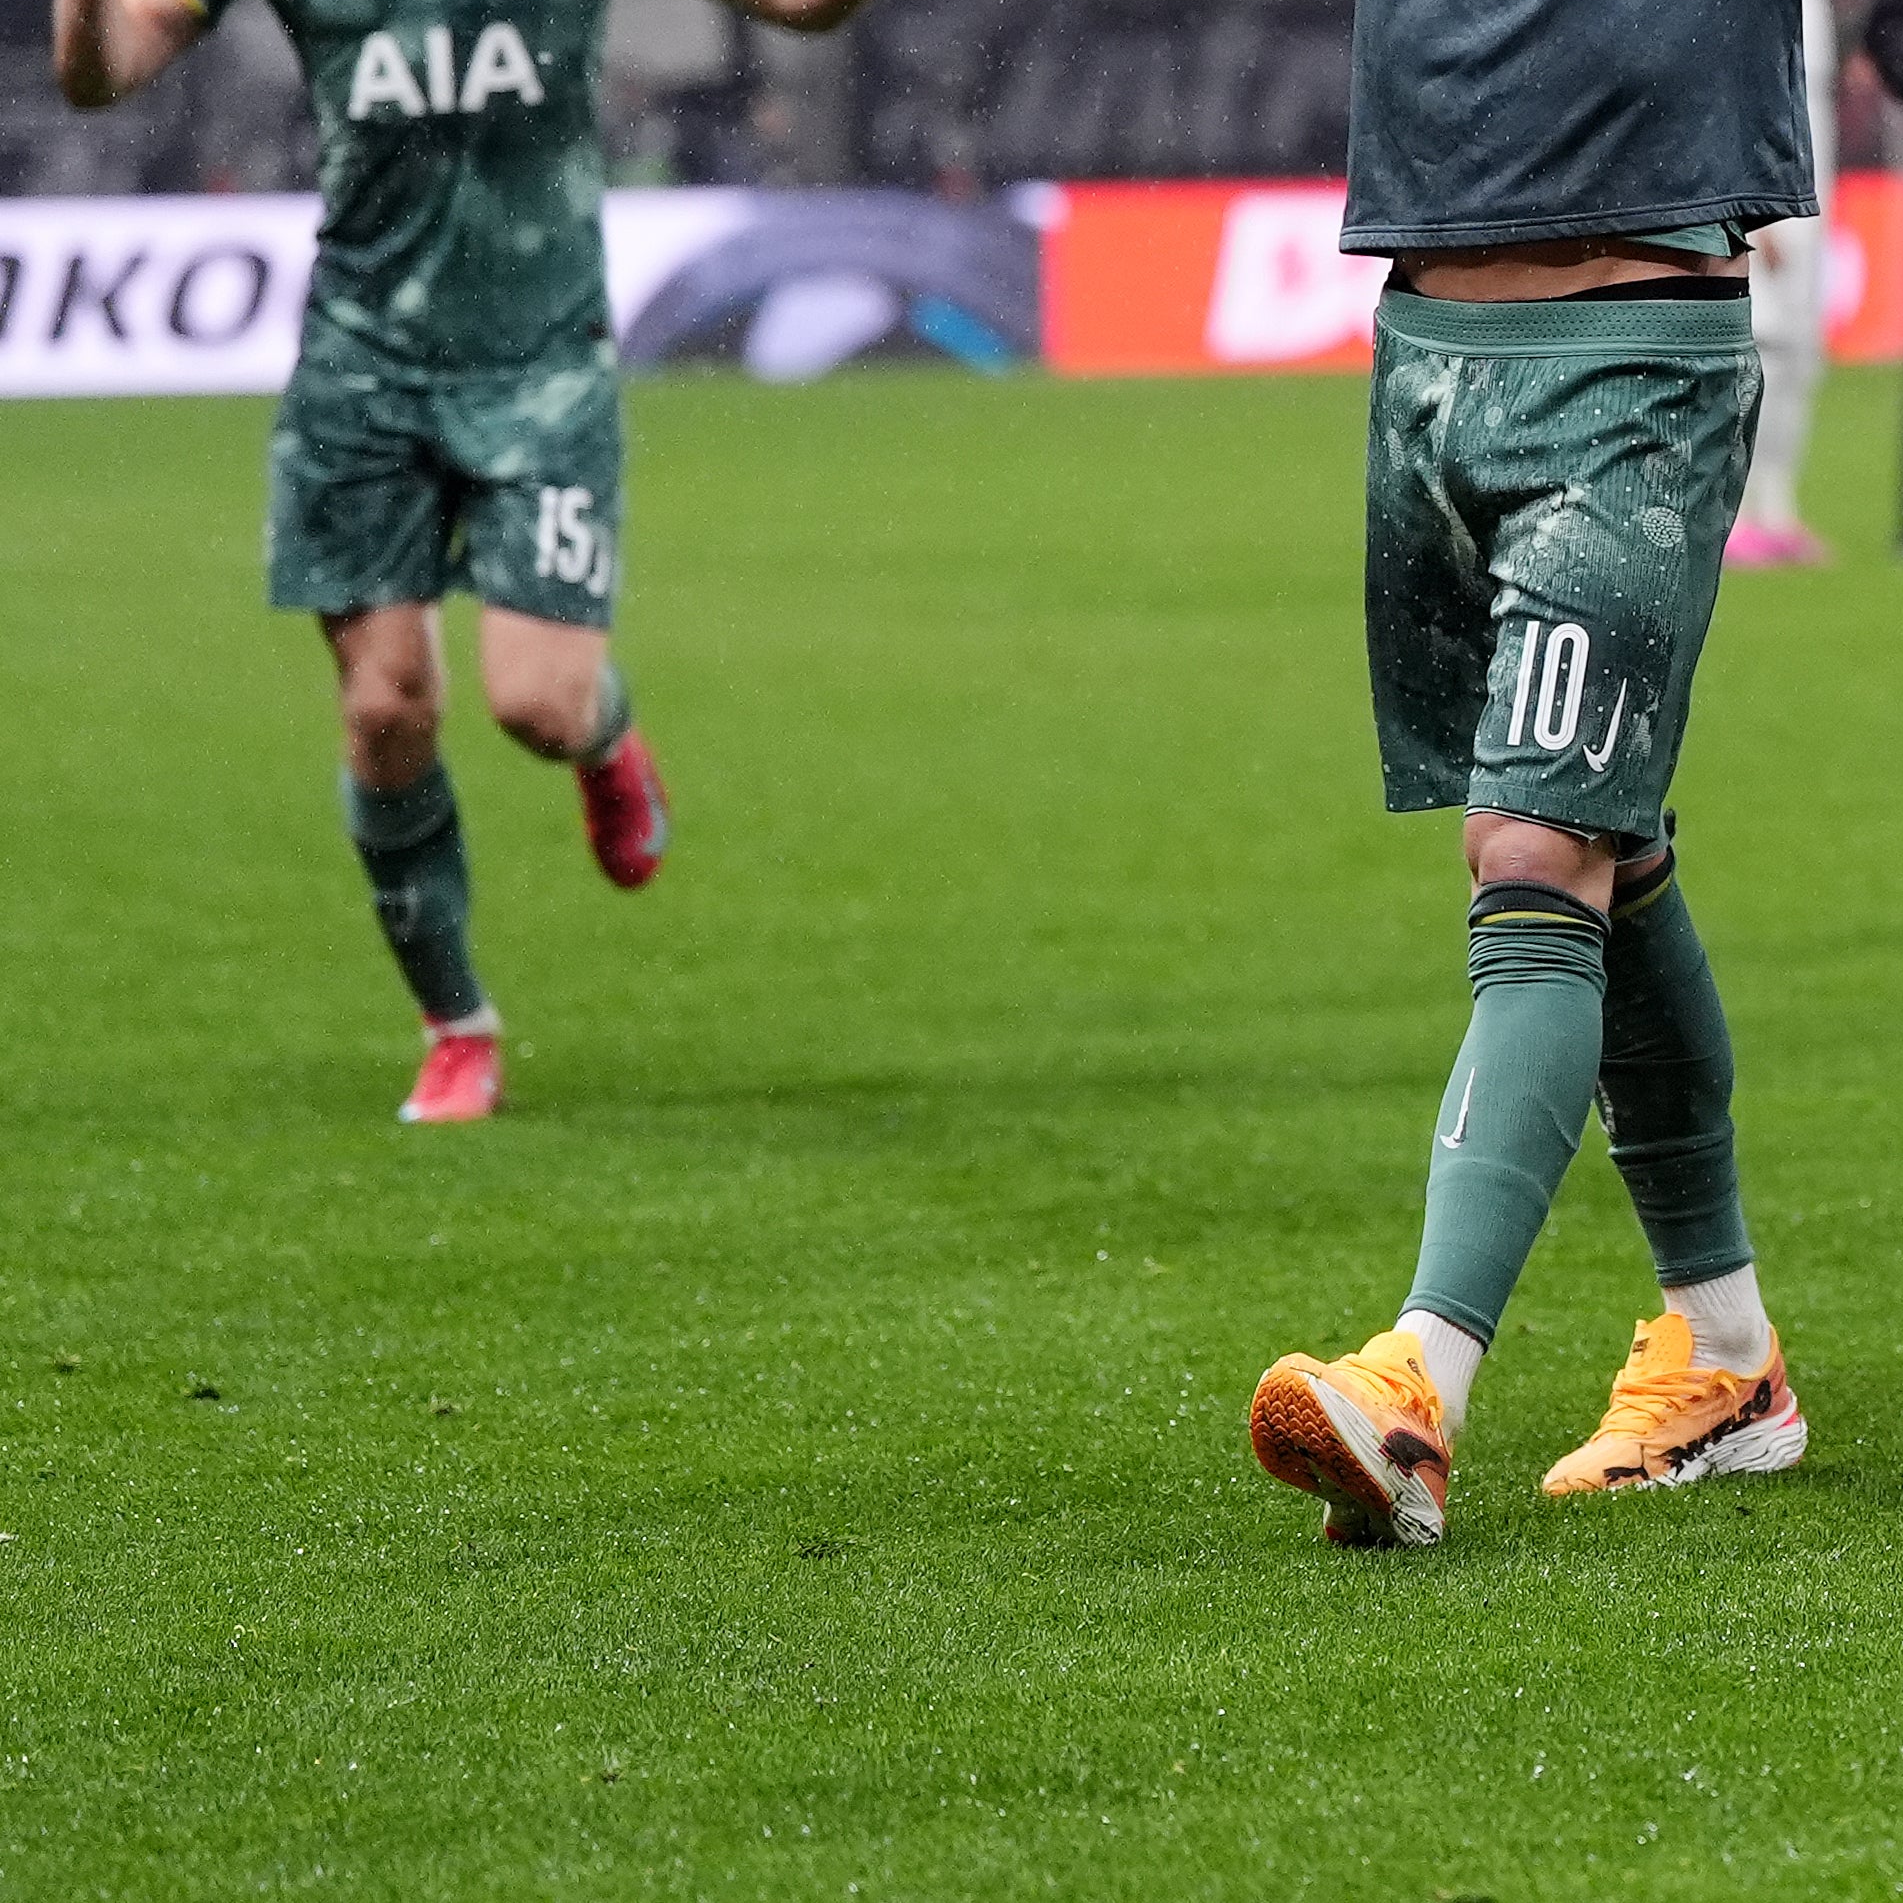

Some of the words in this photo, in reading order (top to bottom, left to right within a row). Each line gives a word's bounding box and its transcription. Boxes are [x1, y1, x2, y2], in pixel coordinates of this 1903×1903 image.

[346, 20, 546, 121] AIA
[537, 485, 594, 584] 15
[1506, 620, 1590, 752] 10
